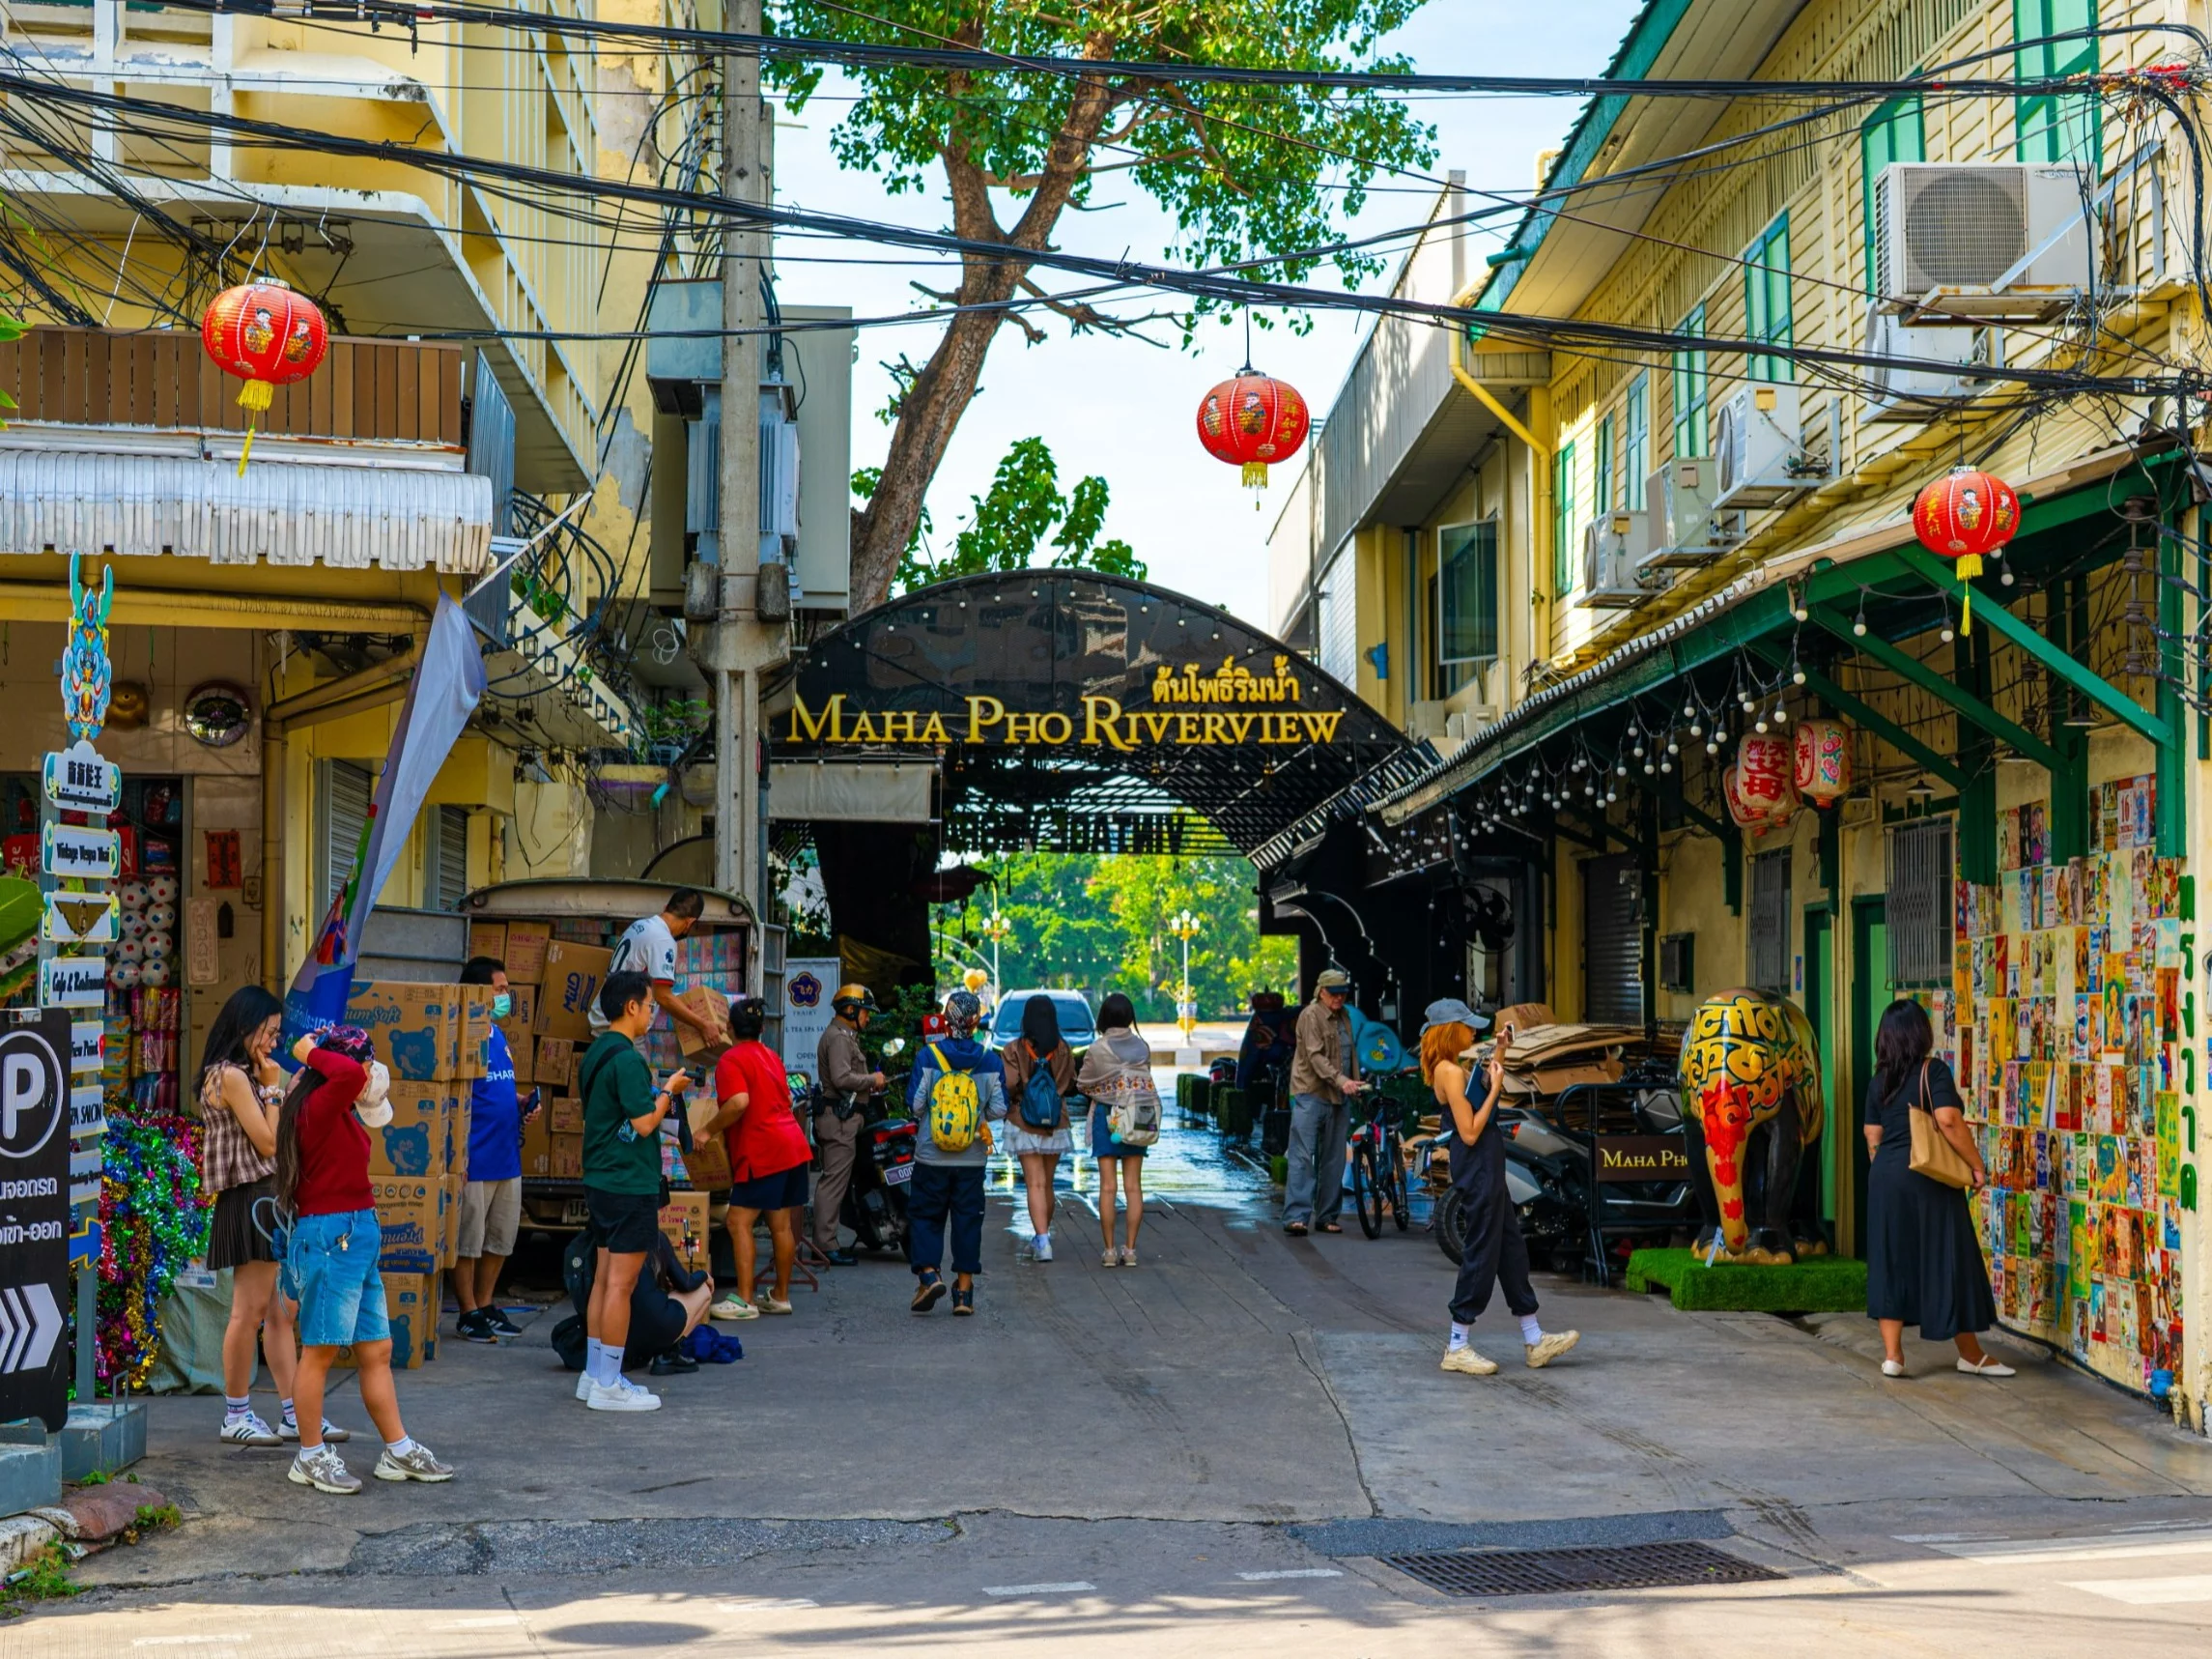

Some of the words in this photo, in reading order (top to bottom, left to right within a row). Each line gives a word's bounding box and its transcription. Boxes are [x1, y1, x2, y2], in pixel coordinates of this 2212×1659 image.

[1152, 655, 1300, 702] ต้นโพธิ์ริมน้ำ
[786, 693, 951, 744] MAHA
[964, 696, 1072, 744] PHO
[1080, 696, 1347, 752] RIVERVIEW
[373, 1006, 400, 1024] Soft
[1600, 1147, 1658, 1168] MAHA
